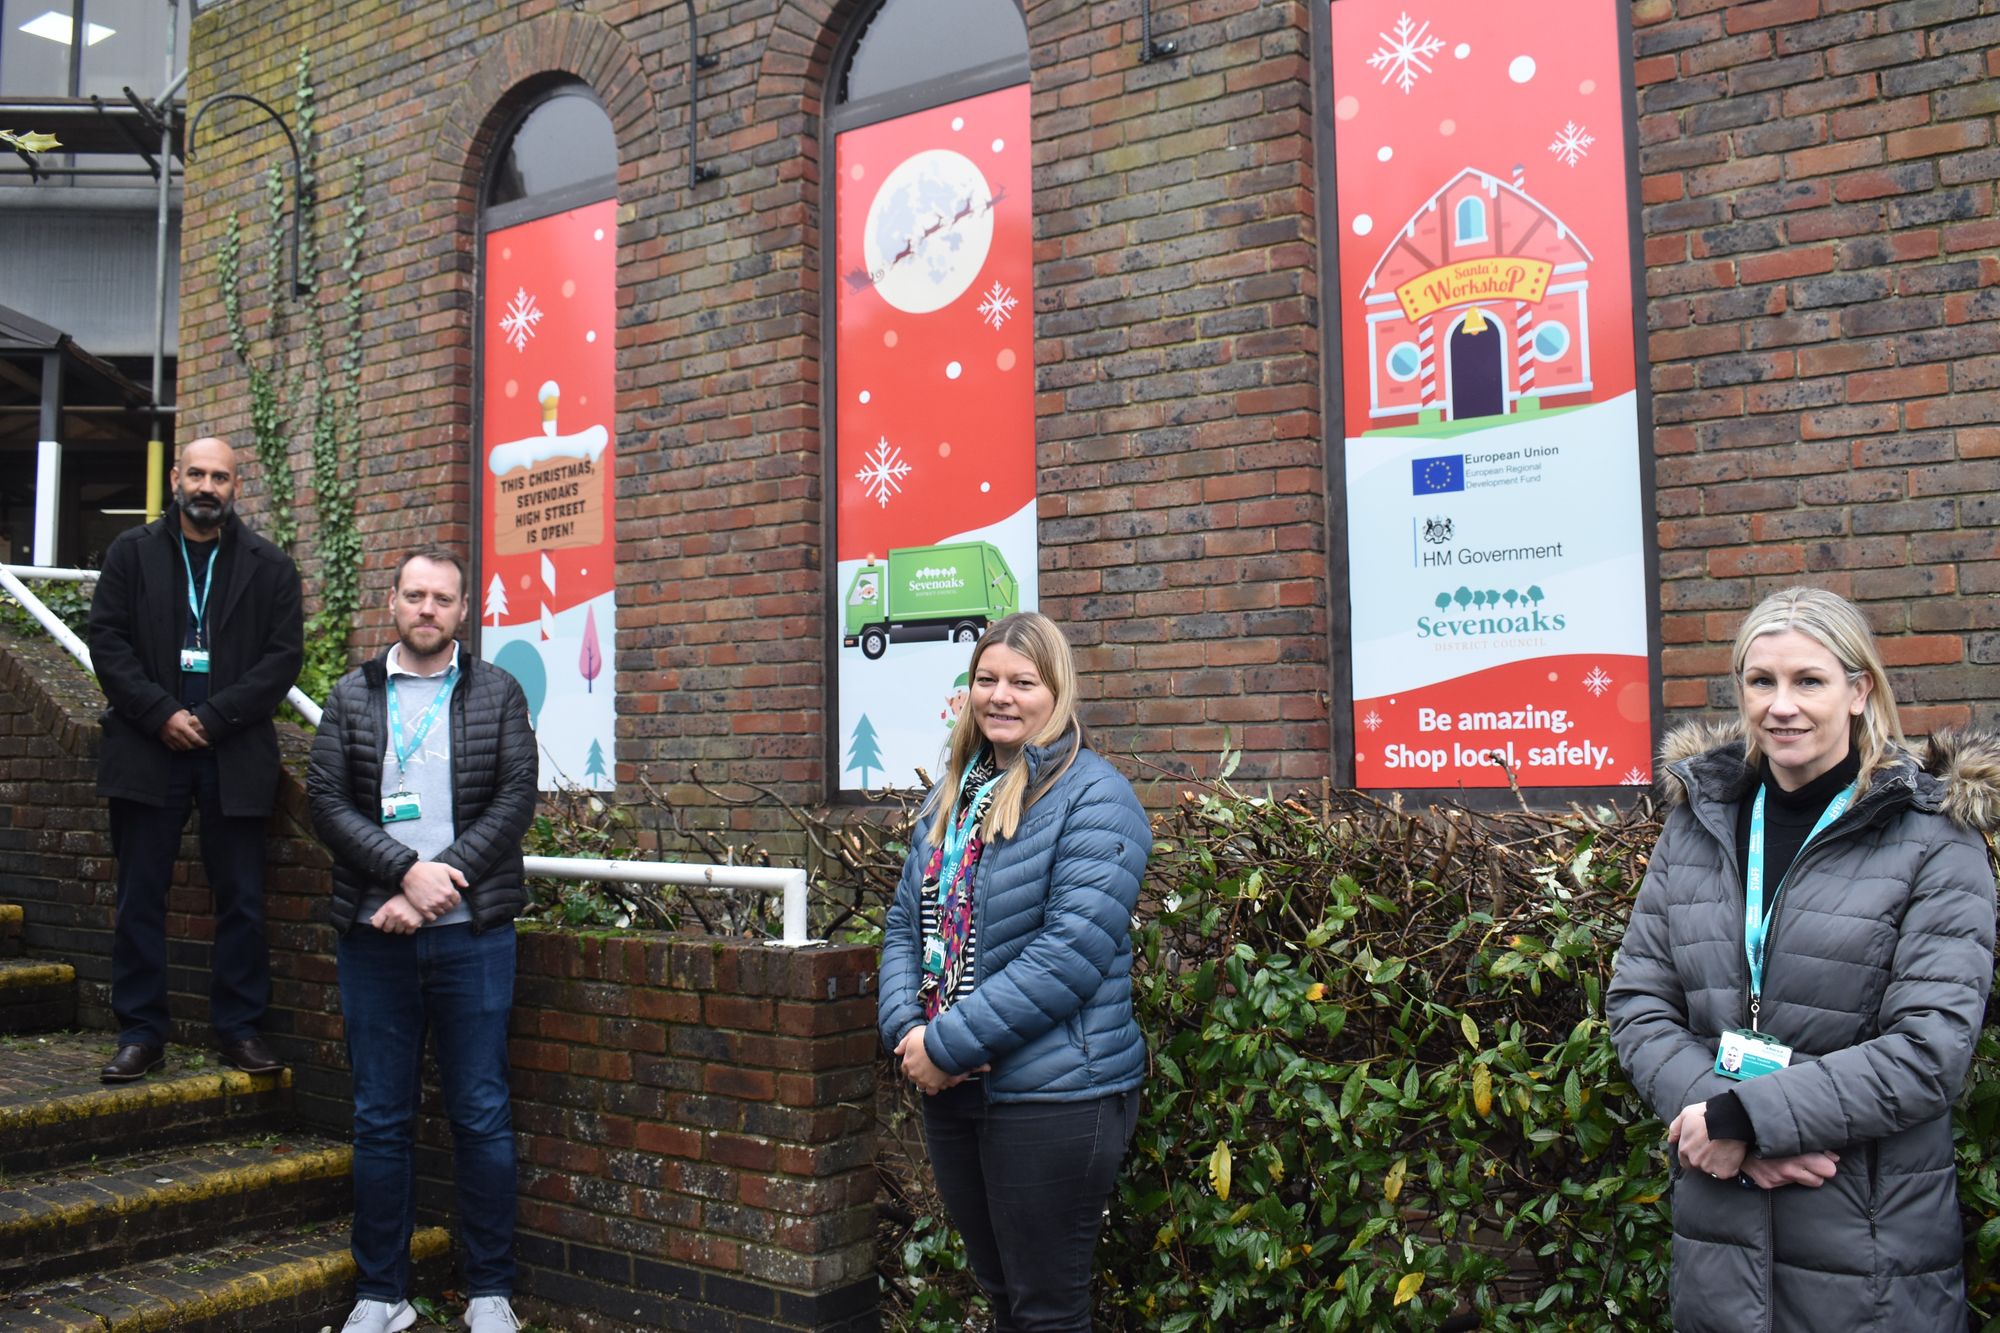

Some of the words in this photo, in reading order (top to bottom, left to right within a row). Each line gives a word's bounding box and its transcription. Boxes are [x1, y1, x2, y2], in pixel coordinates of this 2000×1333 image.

[1454, 261, 1498, 280] Santa's
[1465, 450, 1520, 465] European
[1524, 446, 1559, 458] Union
[501, 477, 525, 493] THIS
[529, 460, 595, 487] CHRISTMAS,
[1466, 467, 1504, 478] European
[1506, 463, 1542, 475] Regional
[1466, 476, 1518, 489] Development
[1520, 474, 1541, 483] Fund
[517, 483, 579, 508] SEVENOAKS
[515, 510, 540, 528] HIGH
[544, 499, 586, 521] STREET
[527, 530, 537, 544] IS
[541, 521, 574, 541] OPEN!
[1423, 550, 1452, 567] HM
[1458, 542, 1563, 565] Government
[909, 578, 965, 592] Sevenoaks
[1417, 610, 1566, 638] Sevenoaks
[1434, 639, 1489, 652] DISTRICT
[1493, 637, 1547, 649] COUNCIL
[1418, 707, 1452, 732] Be
[1457, 704, 1575, 734] amazing.
[1384, 744, 1448, 772] Shop
[1453, 741, 1522, 770] local,
[1528, 739, 1614, 770] safely.
[1828, 796, 1847, 821] STAFF
[946, 861, 958, 885] STAFF
[1750, 867, 1760, 891] STAFF
